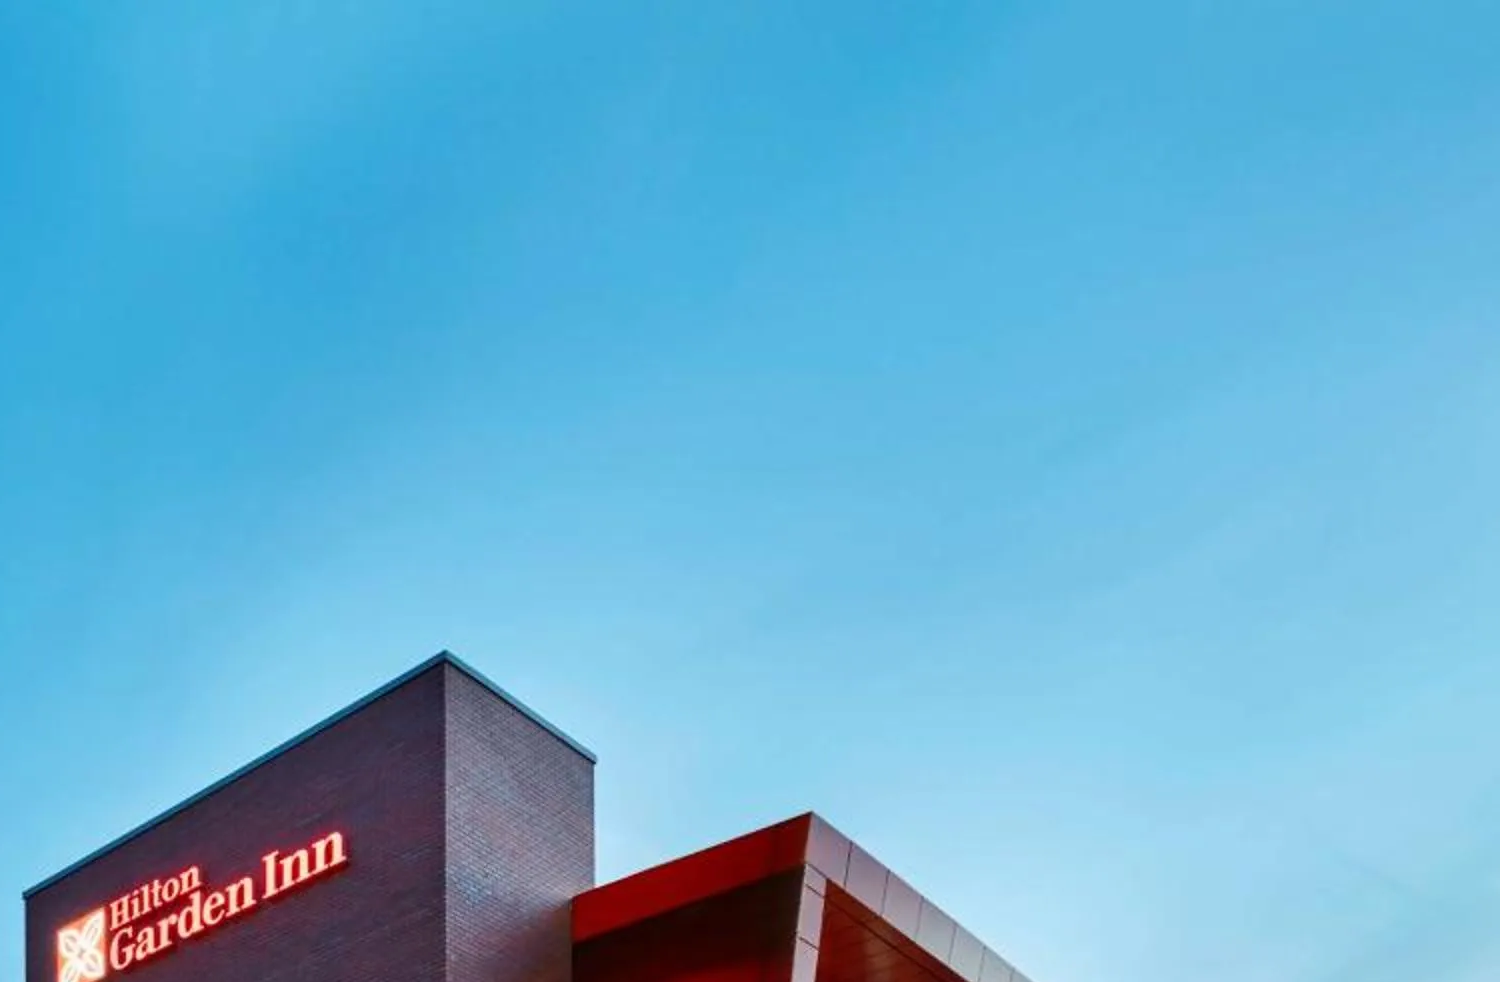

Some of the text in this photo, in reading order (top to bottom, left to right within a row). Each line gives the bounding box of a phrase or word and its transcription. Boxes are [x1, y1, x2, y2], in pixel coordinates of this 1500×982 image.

[109, 866, 200, 931] Hilton
[110, 831, 347, 970] Garden Inn
